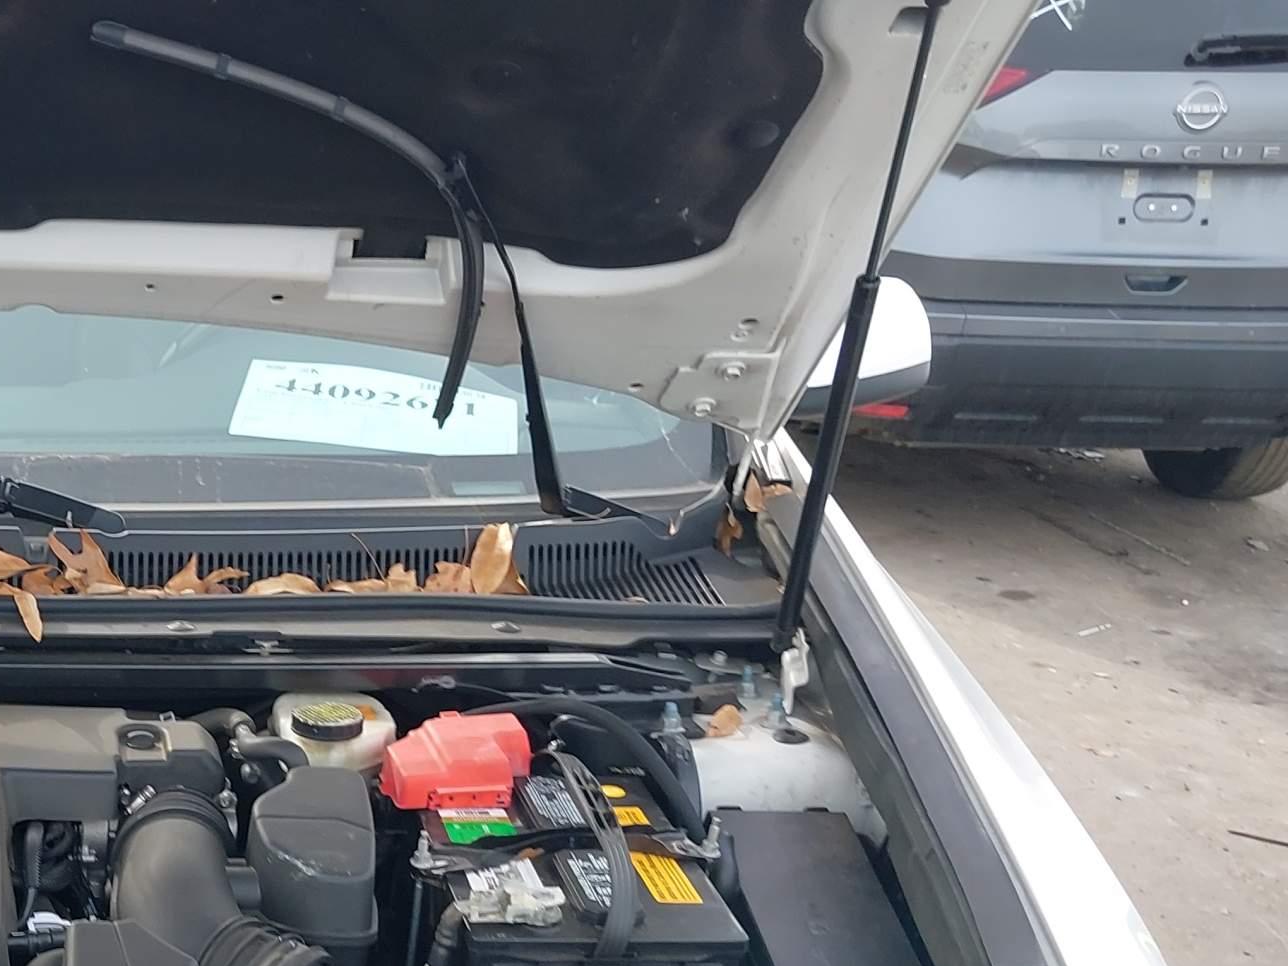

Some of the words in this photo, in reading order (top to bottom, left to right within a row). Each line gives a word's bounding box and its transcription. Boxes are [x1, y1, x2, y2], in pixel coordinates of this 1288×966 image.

[1176, 103, 1228, 114] NISSAN
[1100, 143, 1281, 159] ROGUE
[276, 378, 475, 417] 4409261
